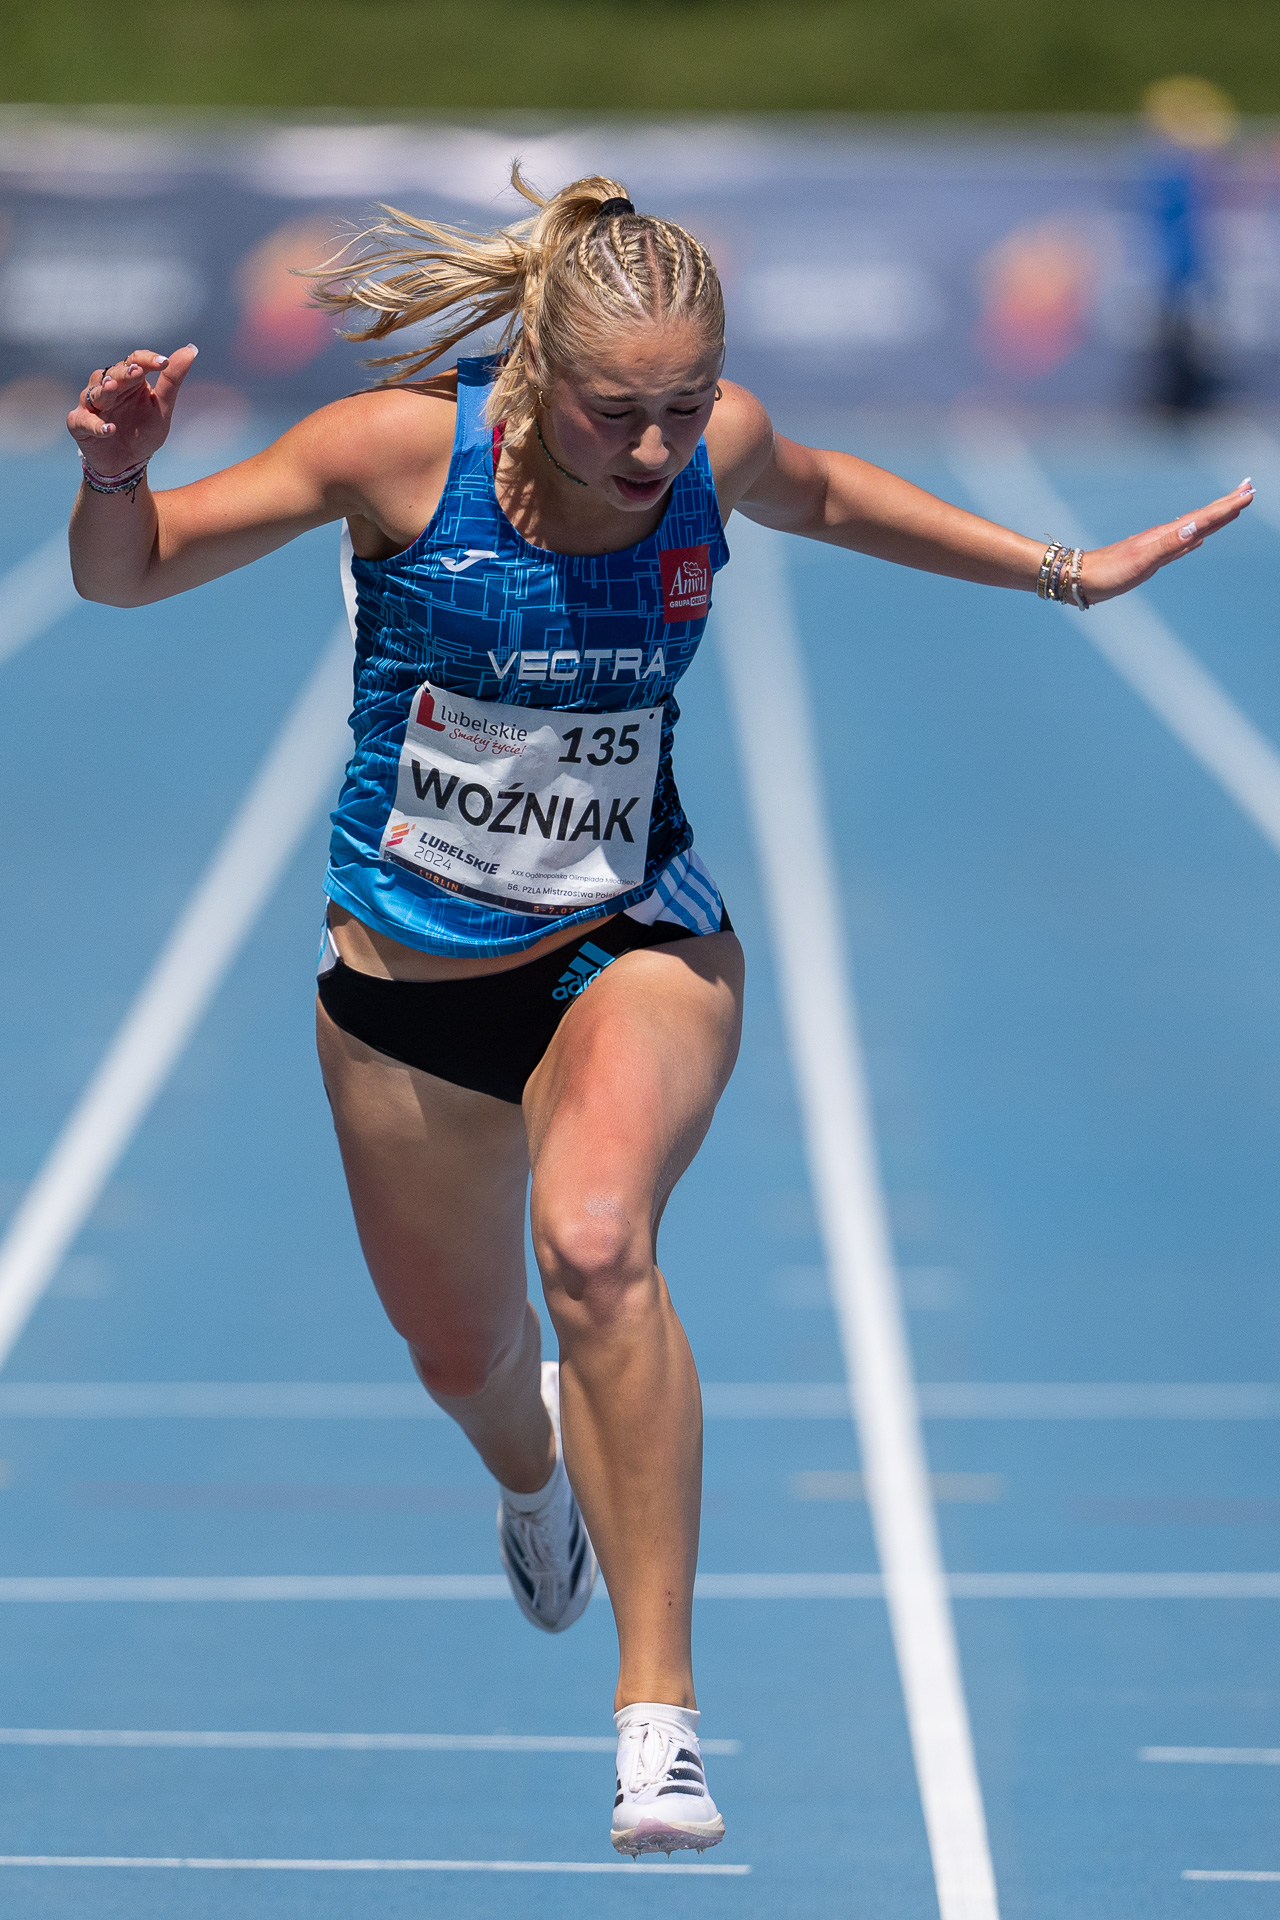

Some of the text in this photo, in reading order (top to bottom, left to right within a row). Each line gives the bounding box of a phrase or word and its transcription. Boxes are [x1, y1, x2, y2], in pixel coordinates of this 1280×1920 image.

[669, 566, 707, 596] Anwil
[669, 598, 690, 608] GRUPA
[487, 647, 666, 681] VECTRA
[449, 728, 527, 758] Smakuj życie!
[558, 724, 640, 767] 135
[411, 759, 641, 843] WOŹNIAK
[414, 845, 452, 871] 2024
[419, 832, 501, 875] LUBELSKIE
[419, 869, 459, 892] LUBLIN
[507, 883, 520, 892] 56.
[543, 887, 594, 899] Mistrzostwa
[511, 869, 524, 877] XXX
[525, 871, 568, 881] Ogólnopolska
[569, 874, 604, 883] Olimpiada
